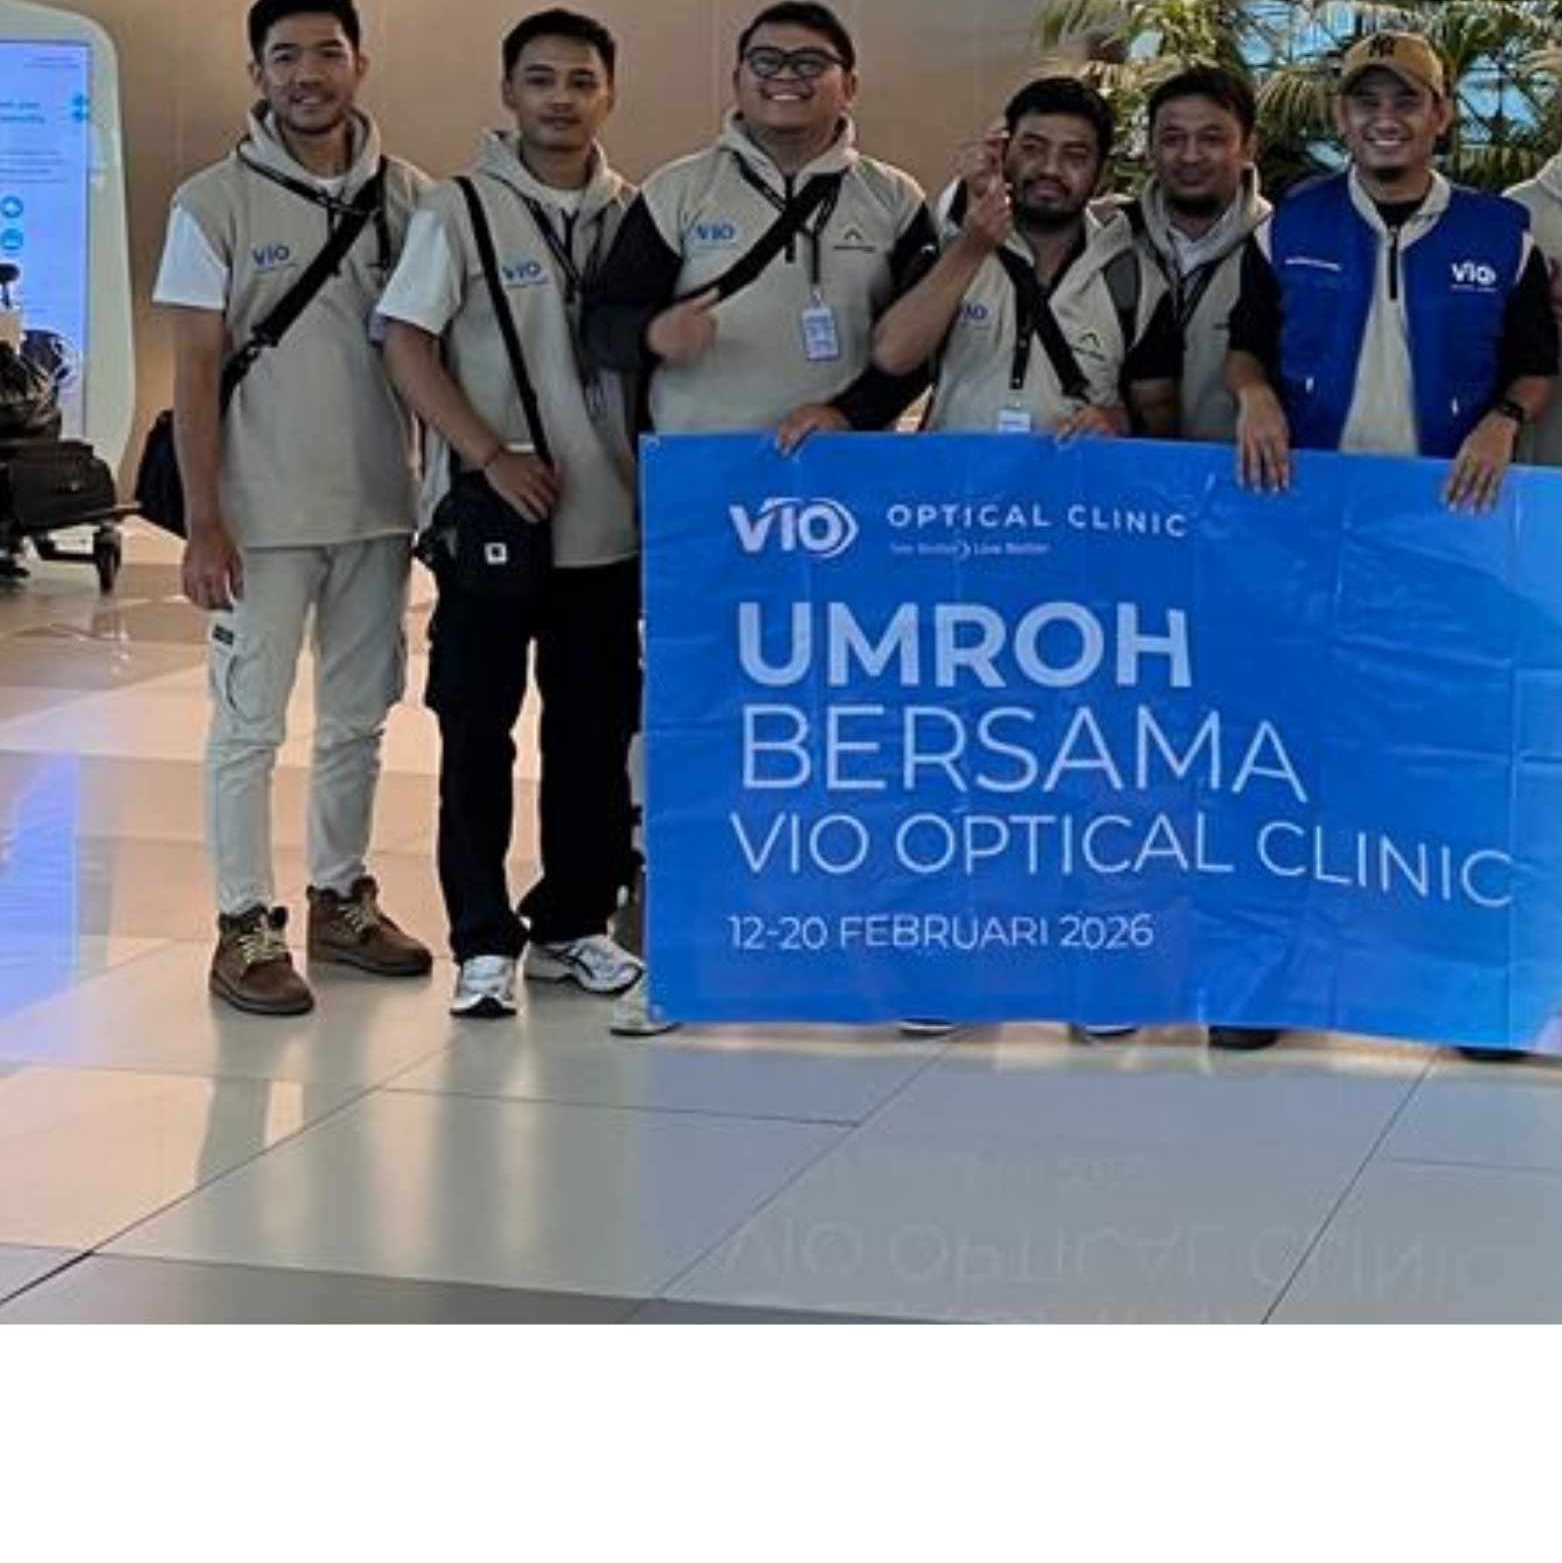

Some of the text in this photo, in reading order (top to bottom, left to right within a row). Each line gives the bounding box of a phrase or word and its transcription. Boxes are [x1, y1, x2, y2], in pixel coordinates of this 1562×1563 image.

[729, 497, 858, 558] VIO
[887, 504, 1186, 538] OPTICAL CLINIC
[738, 602, 1193, 689] UMROH
[742, 704, 1309, 803] BERSAMA
[731, 813, 1512, 909] VIO OPTICAL CLINIC
[730, 913, 1155, 952] 12-20 FEBRUARI 2026
